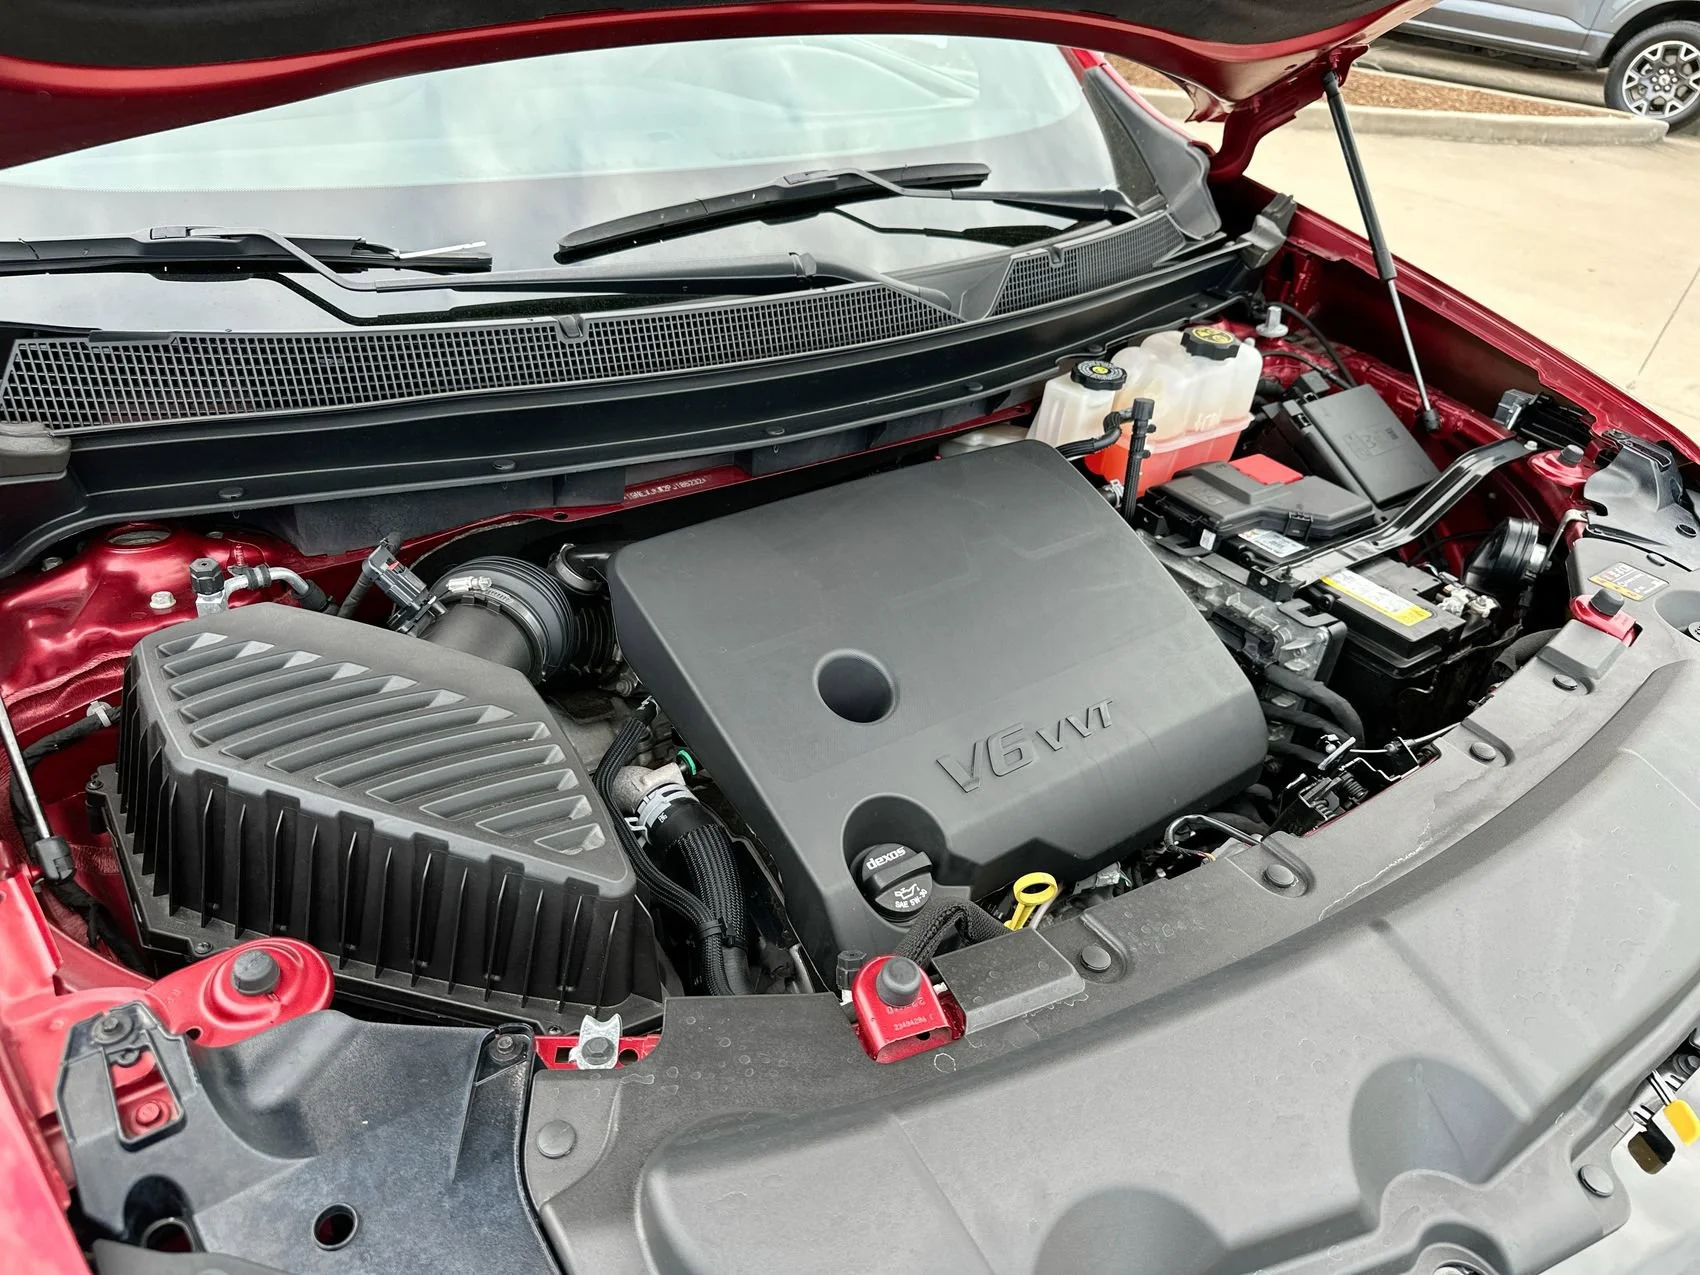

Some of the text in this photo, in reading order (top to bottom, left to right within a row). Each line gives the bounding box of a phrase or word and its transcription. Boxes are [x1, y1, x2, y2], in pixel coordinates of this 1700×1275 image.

[935, 697, 1113, 793] V6 VVT
[866, 846, 906, 870] dexos
[895, 888, 928, 909] SAE 5W-30
